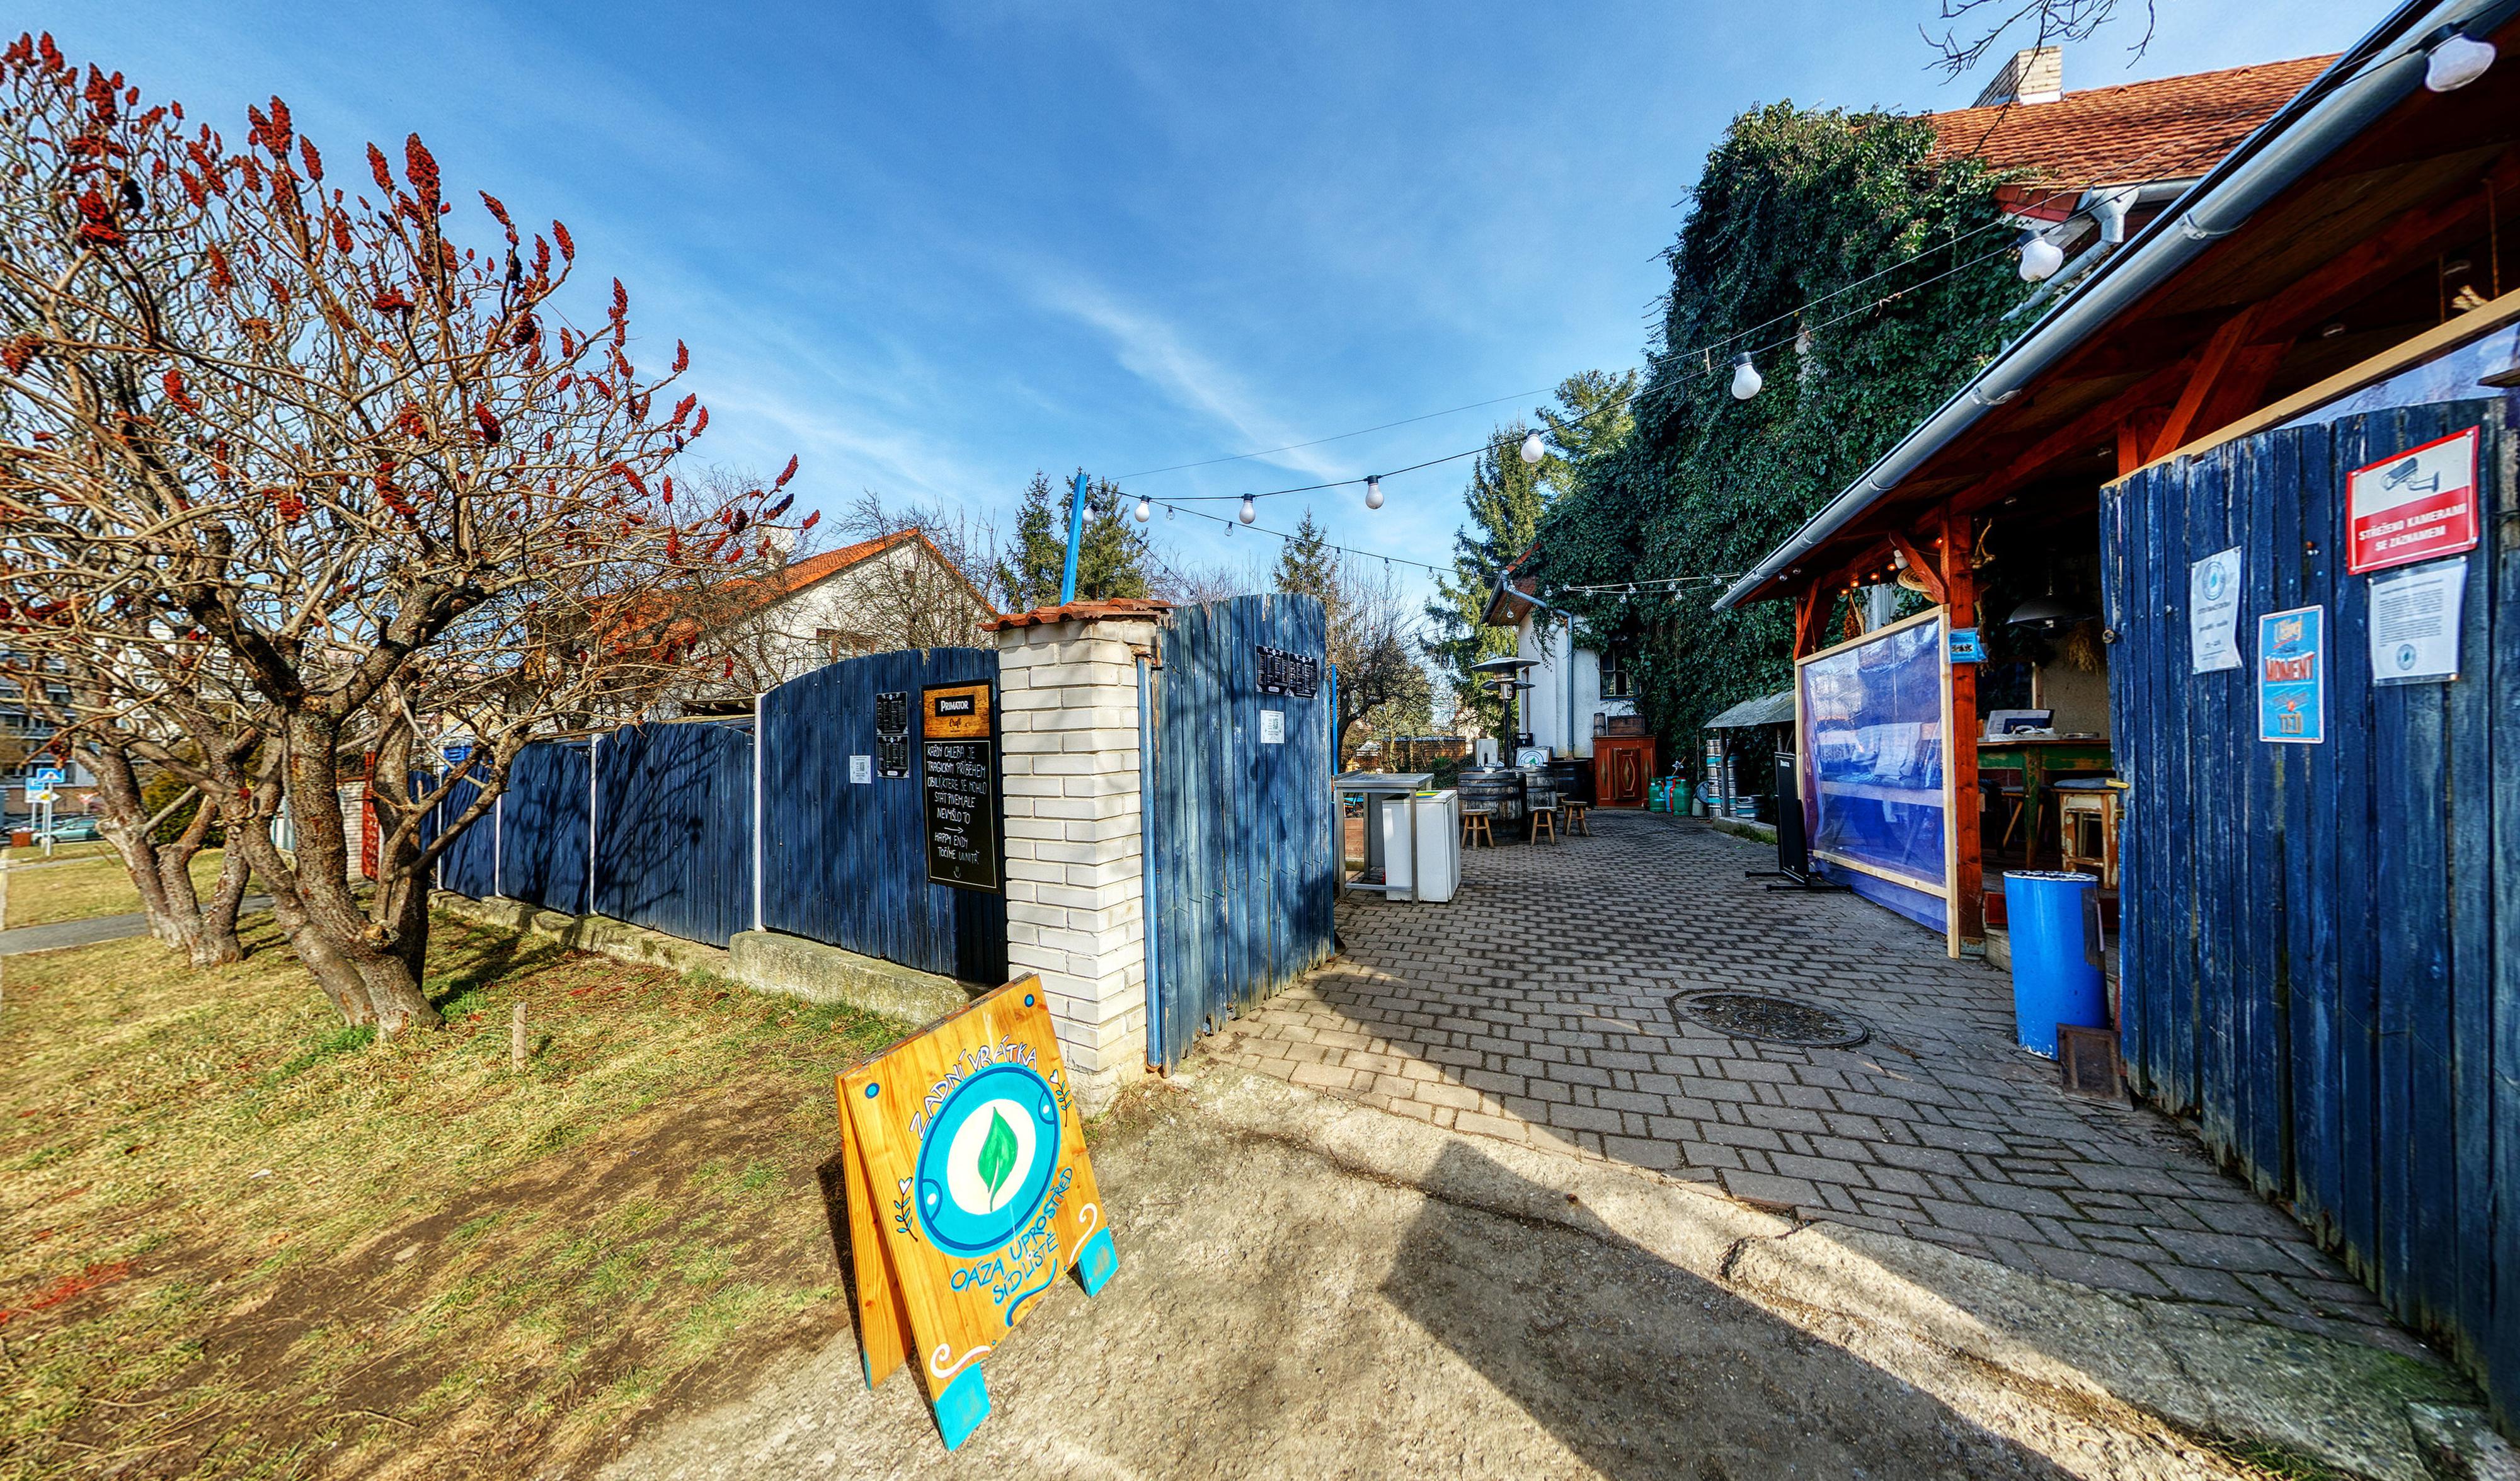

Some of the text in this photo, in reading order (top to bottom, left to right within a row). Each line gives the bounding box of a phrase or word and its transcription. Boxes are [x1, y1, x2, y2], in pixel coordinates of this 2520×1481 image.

[2374, 540, 2388, 551] SE
[944, 746, 965, 758] CHLEBA
[968, 746, 975, 759] JE
[934, 832, 951, 845] HAPPY
[909, 1034, 1037, 1141] ZADNÍ VRÁTKA
[951, 1167, 1073, 1292] OÁZA UPROSTŘED
